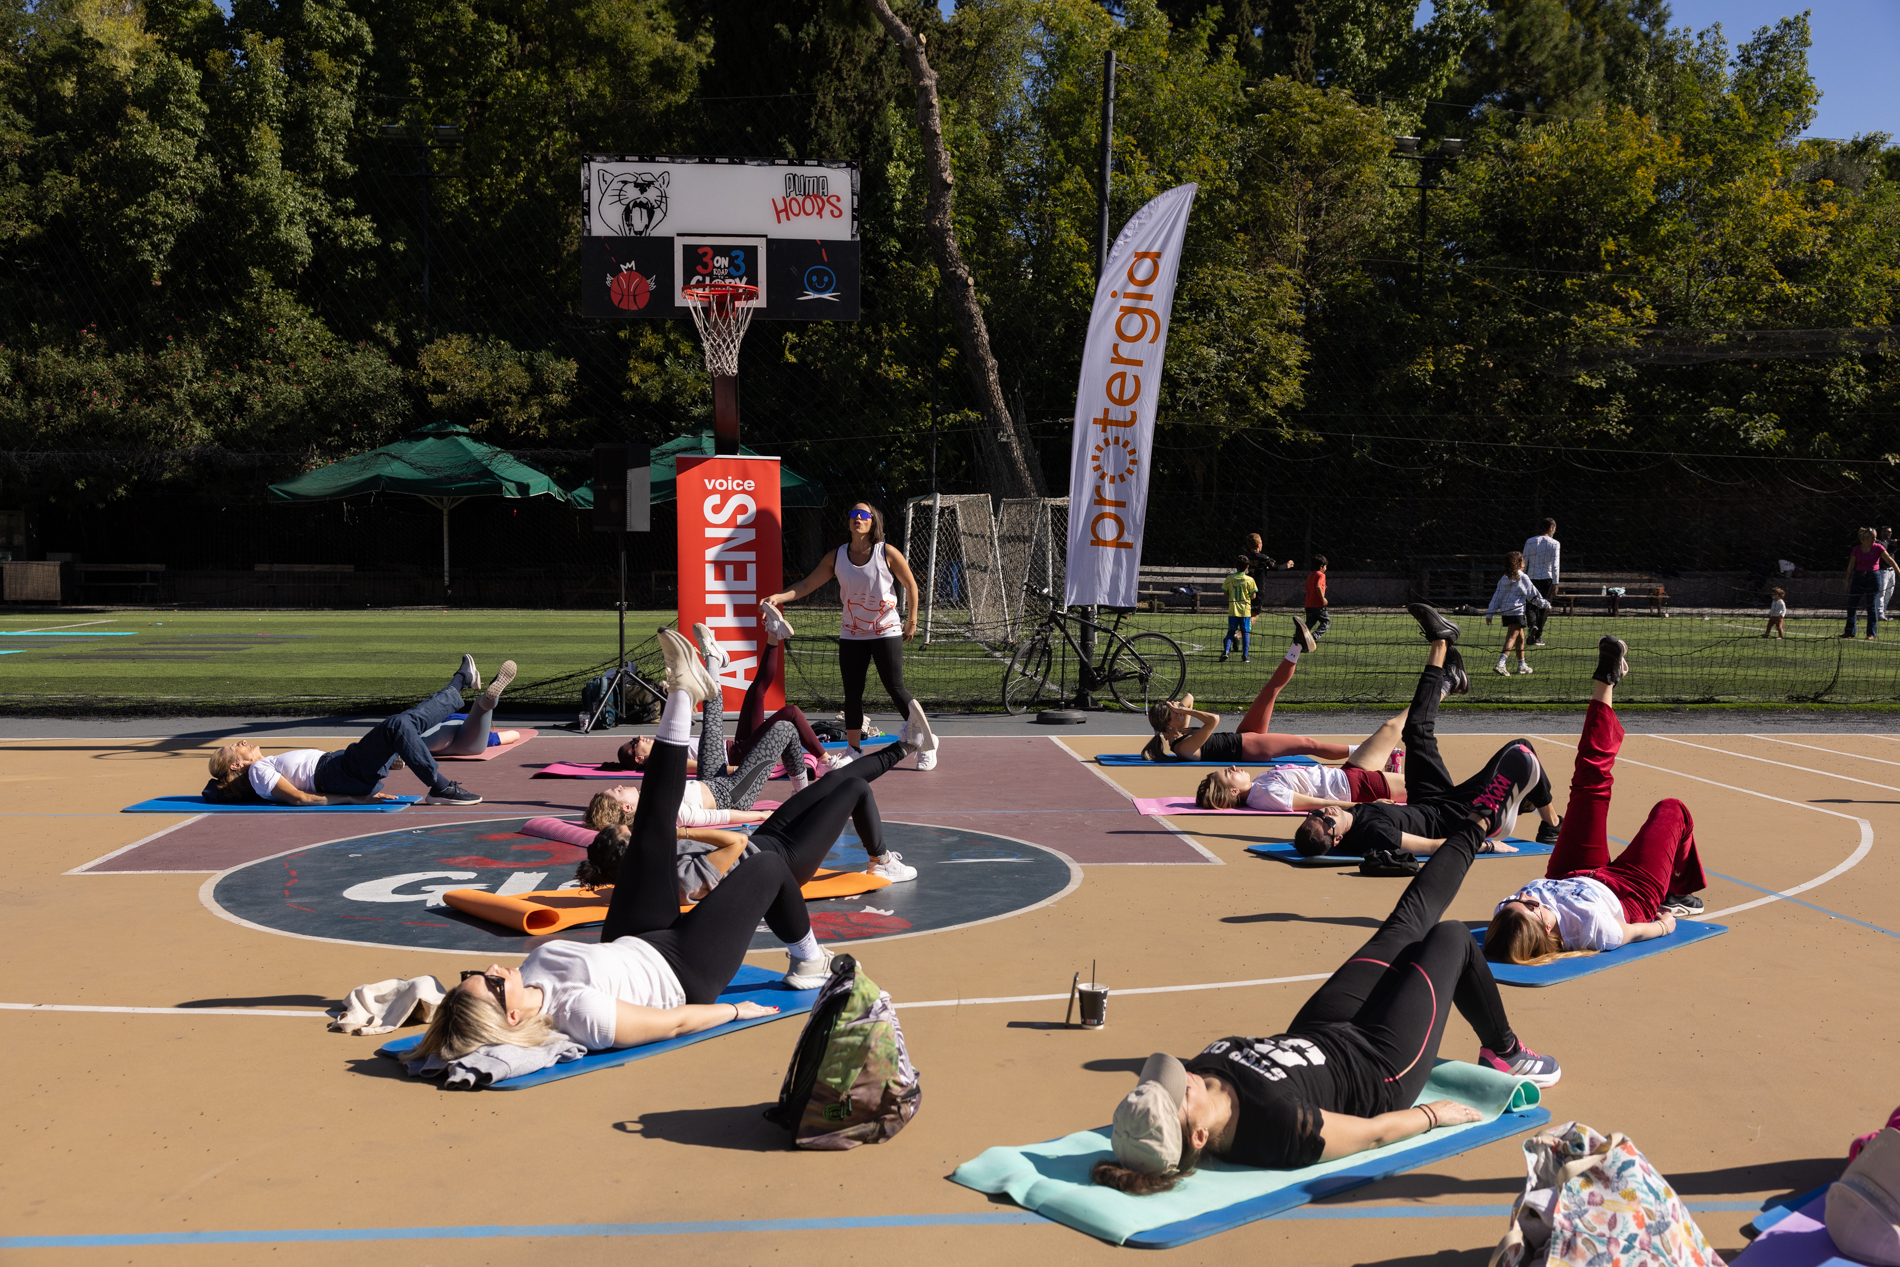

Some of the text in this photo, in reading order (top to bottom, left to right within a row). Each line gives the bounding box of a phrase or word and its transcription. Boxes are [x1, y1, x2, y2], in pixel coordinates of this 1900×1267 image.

[785, 173, 828, 198] PUMA
[771, 193, 843, 224] HOOPS
[695, 246, 746, 277] 3 ON 3
[1090, 251, 1162, 550] protergia
[703, 476, 756, 491] voice
